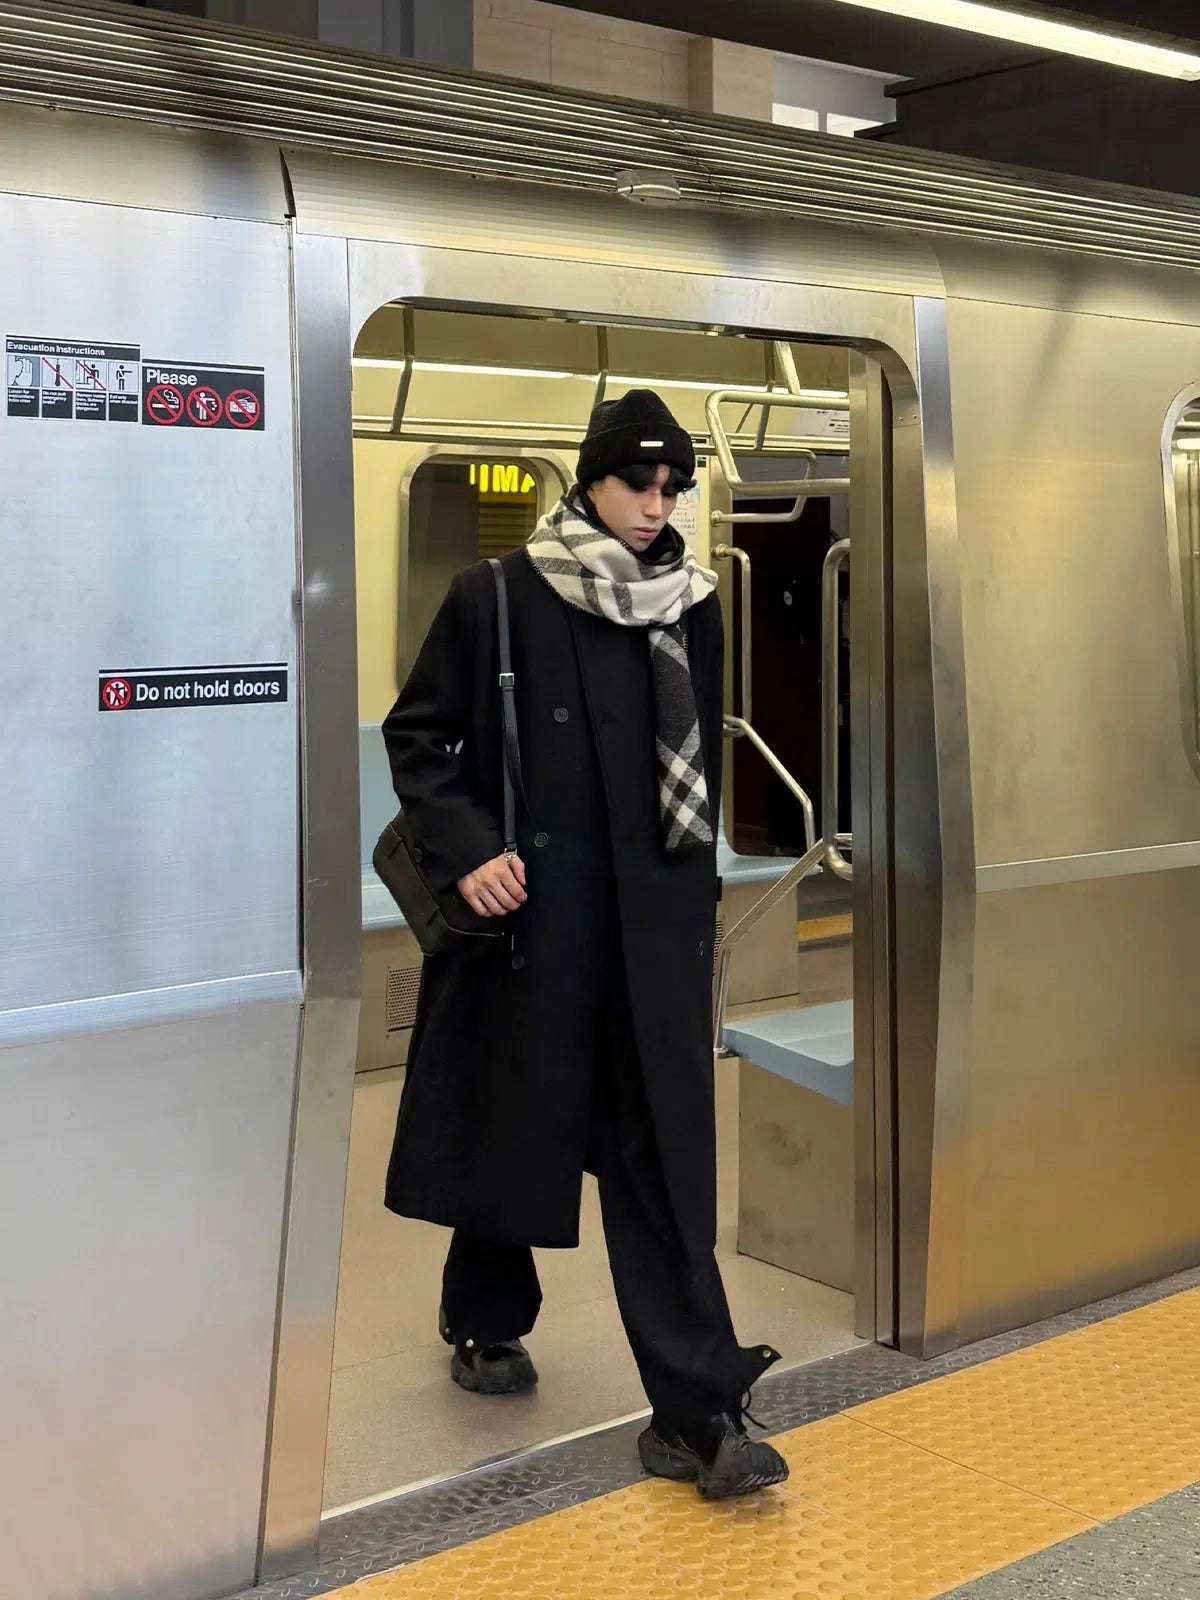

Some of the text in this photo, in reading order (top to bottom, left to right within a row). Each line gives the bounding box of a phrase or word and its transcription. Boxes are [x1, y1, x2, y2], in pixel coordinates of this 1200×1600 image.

[7, 342, 105, 356] Evacuation Instructions
[146, 368, 198, 386] Please
[136, 679, 280, 702] Do not hold doors
